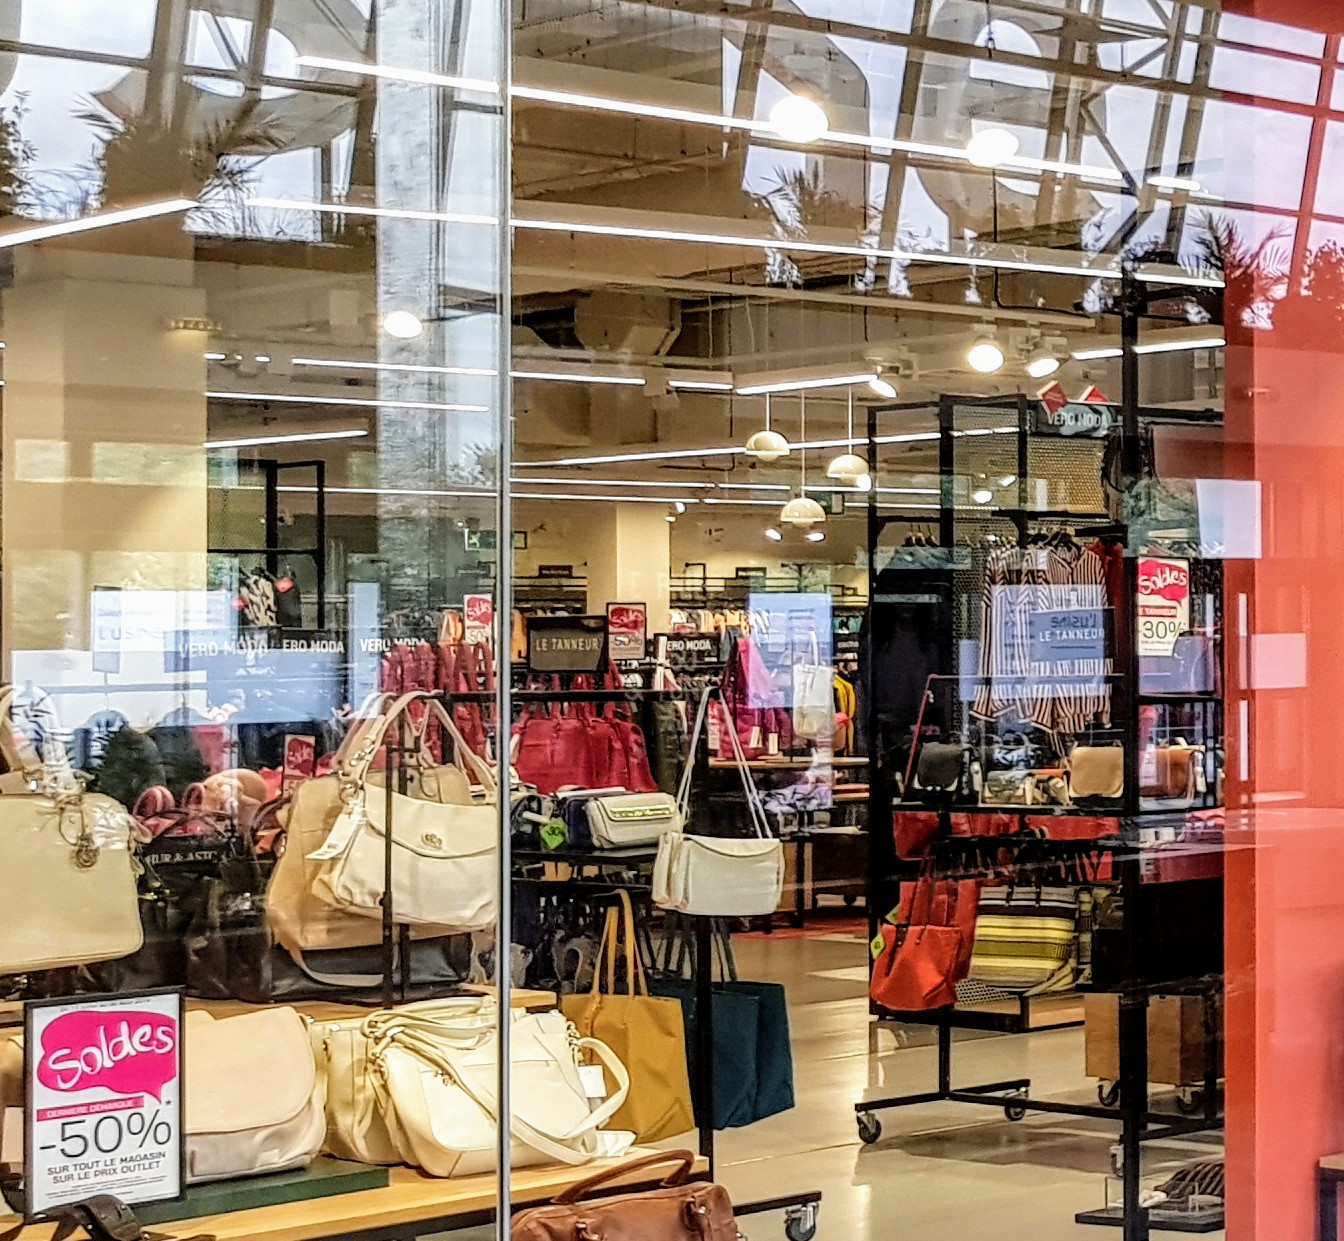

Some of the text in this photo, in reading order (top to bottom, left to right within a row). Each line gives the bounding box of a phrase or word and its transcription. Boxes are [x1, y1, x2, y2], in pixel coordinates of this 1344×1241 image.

[1139, 566, 1187, 595] Soldes
[282, 639, 345, 653] ERO MODA
[535, 638, 600, 651] LE TANNEUR
[666, 640, 685, 652] ERO
[1039, 630, 1052, 642] LE
[47, 1020, 175, 1090] Soldes
[40, 1108, 172, 1158] -50%
[47, 1151, 167, 1176] SUR TOUT LE MAGASIN
[52, 1160, 161, 1185] SUR LE PRIX OUTLET
